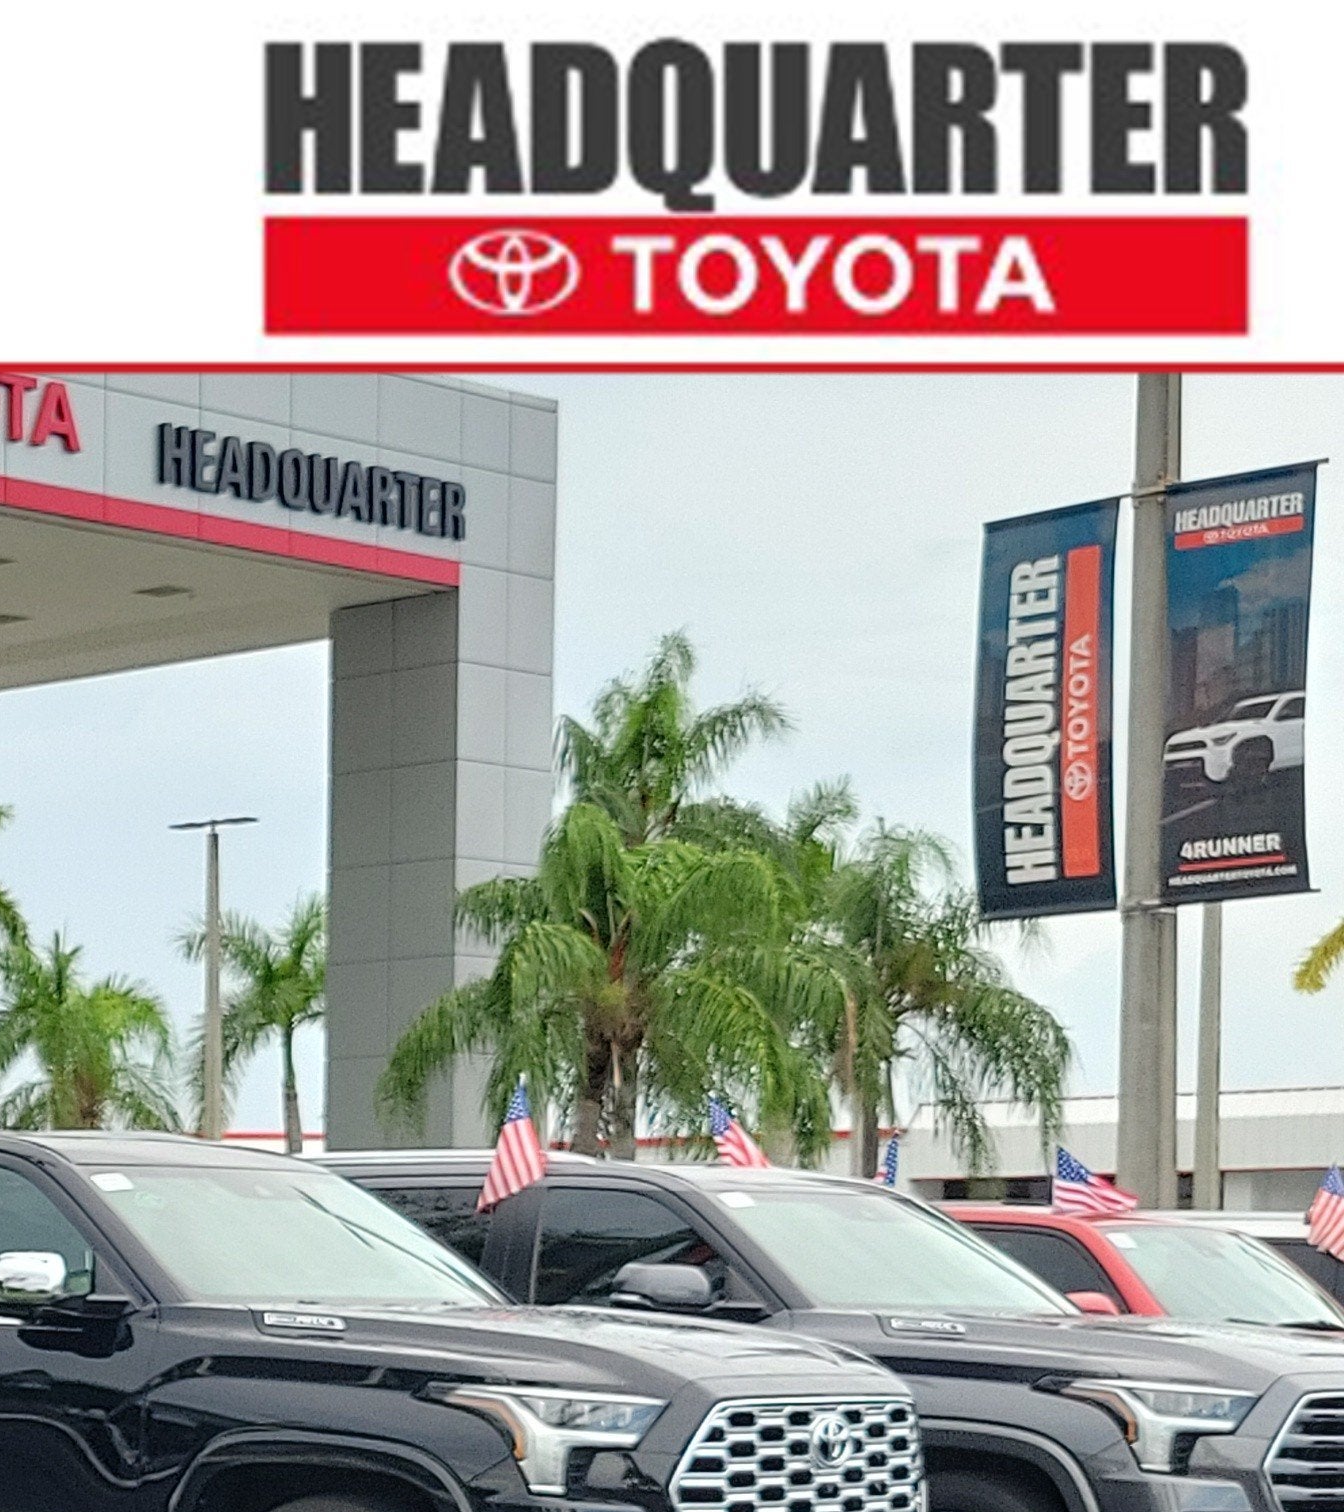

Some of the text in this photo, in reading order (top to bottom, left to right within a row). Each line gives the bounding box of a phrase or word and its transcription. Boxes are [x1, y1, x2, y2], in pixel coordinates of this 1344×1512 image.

[157, 422, 466, 540] HEADQUARTER
[1174, 492, 1304, 533] HEADQUARTER
[1220, 523, 1270, 540] TOYOTA
[1002, 554, 1060, 884] HEADQUARTER
[1067, 632, 1092, 759] TOYOTA
[1179, 832, 1282, 860] 4RUNNER
